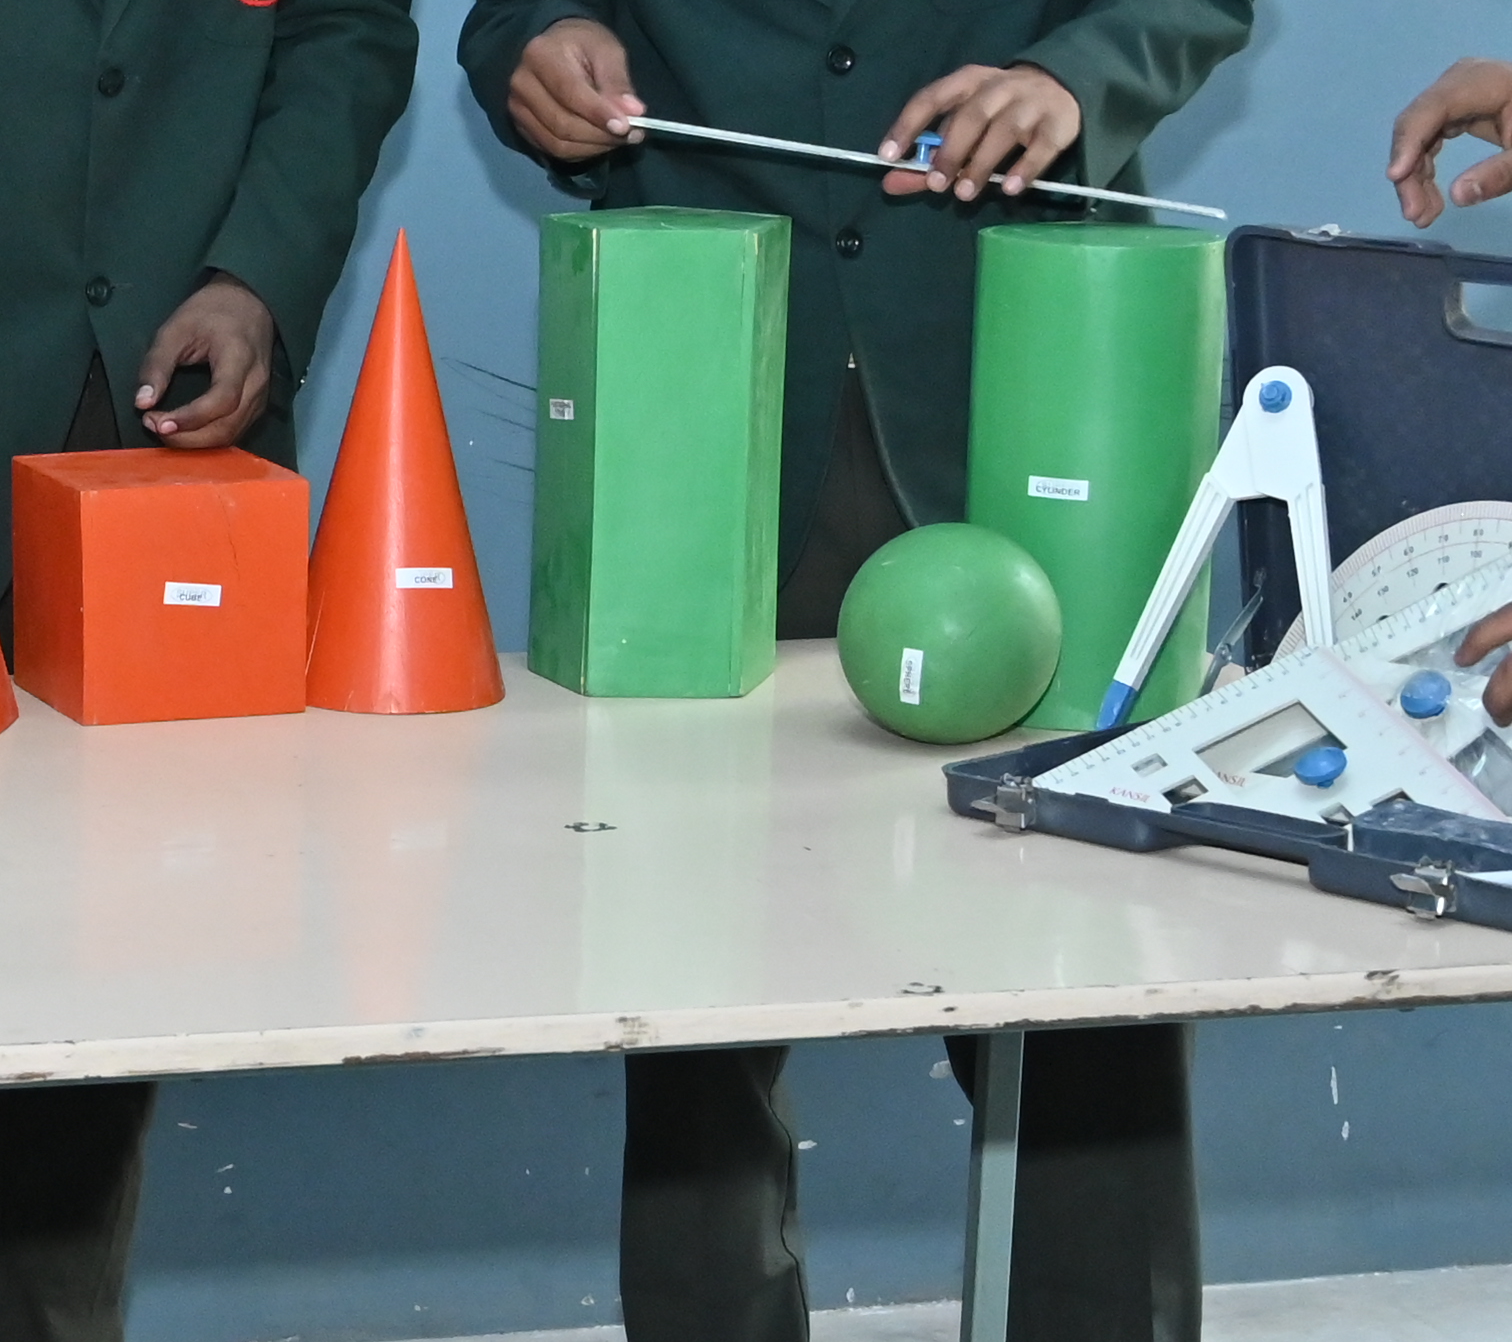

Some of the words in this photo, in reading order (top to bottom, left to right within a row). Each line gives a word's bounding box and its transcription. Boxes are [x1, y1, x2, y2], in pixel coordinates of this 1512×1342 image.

[1035, 485, 1081, 496] CYLINDER
[414, 576, 438, 584] CONE
[179, 593, 202, 602] CUBE
